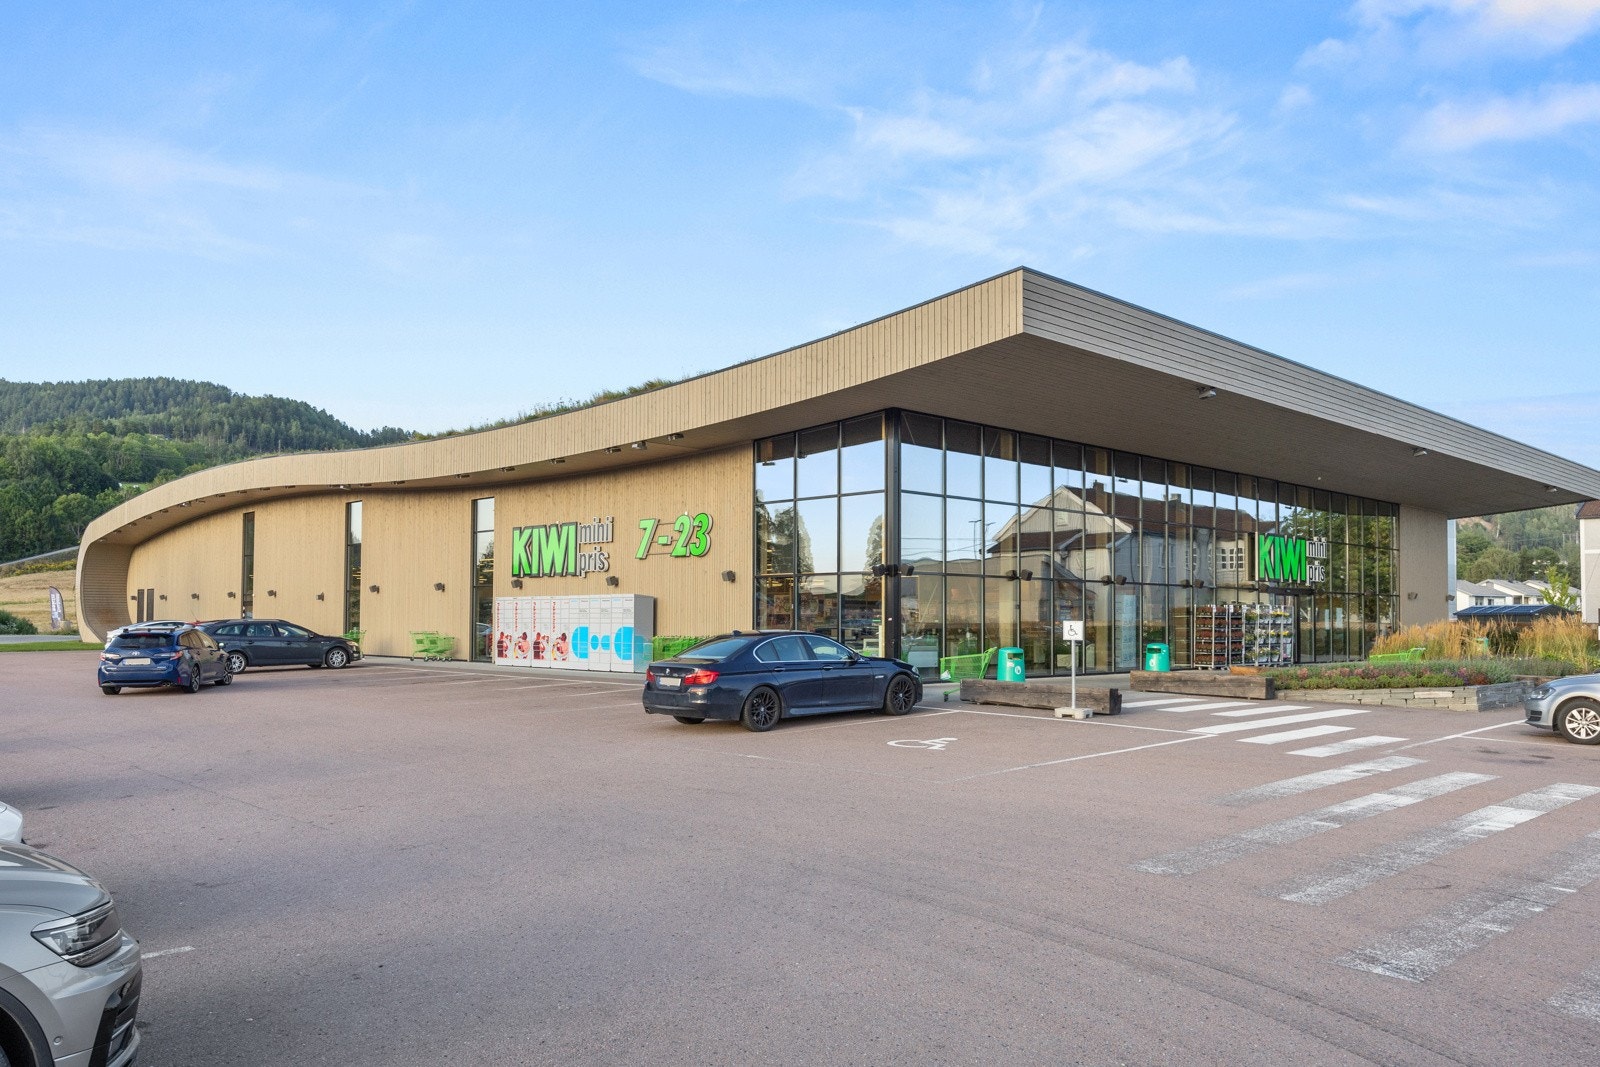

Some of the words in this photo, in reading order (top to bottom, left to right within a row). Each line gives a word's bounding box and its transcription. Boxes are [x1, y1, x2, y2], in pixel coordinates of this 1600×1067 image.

[512, 523, 577, 576] KIWI
[579, 517, 612, 542] mini
[579, 547, 608, 576] pris
[1258, 534, 1306, 581] KIWI
[1307, 537, 1327, 557] mini
[1307, 562, 1325, 585] pris
